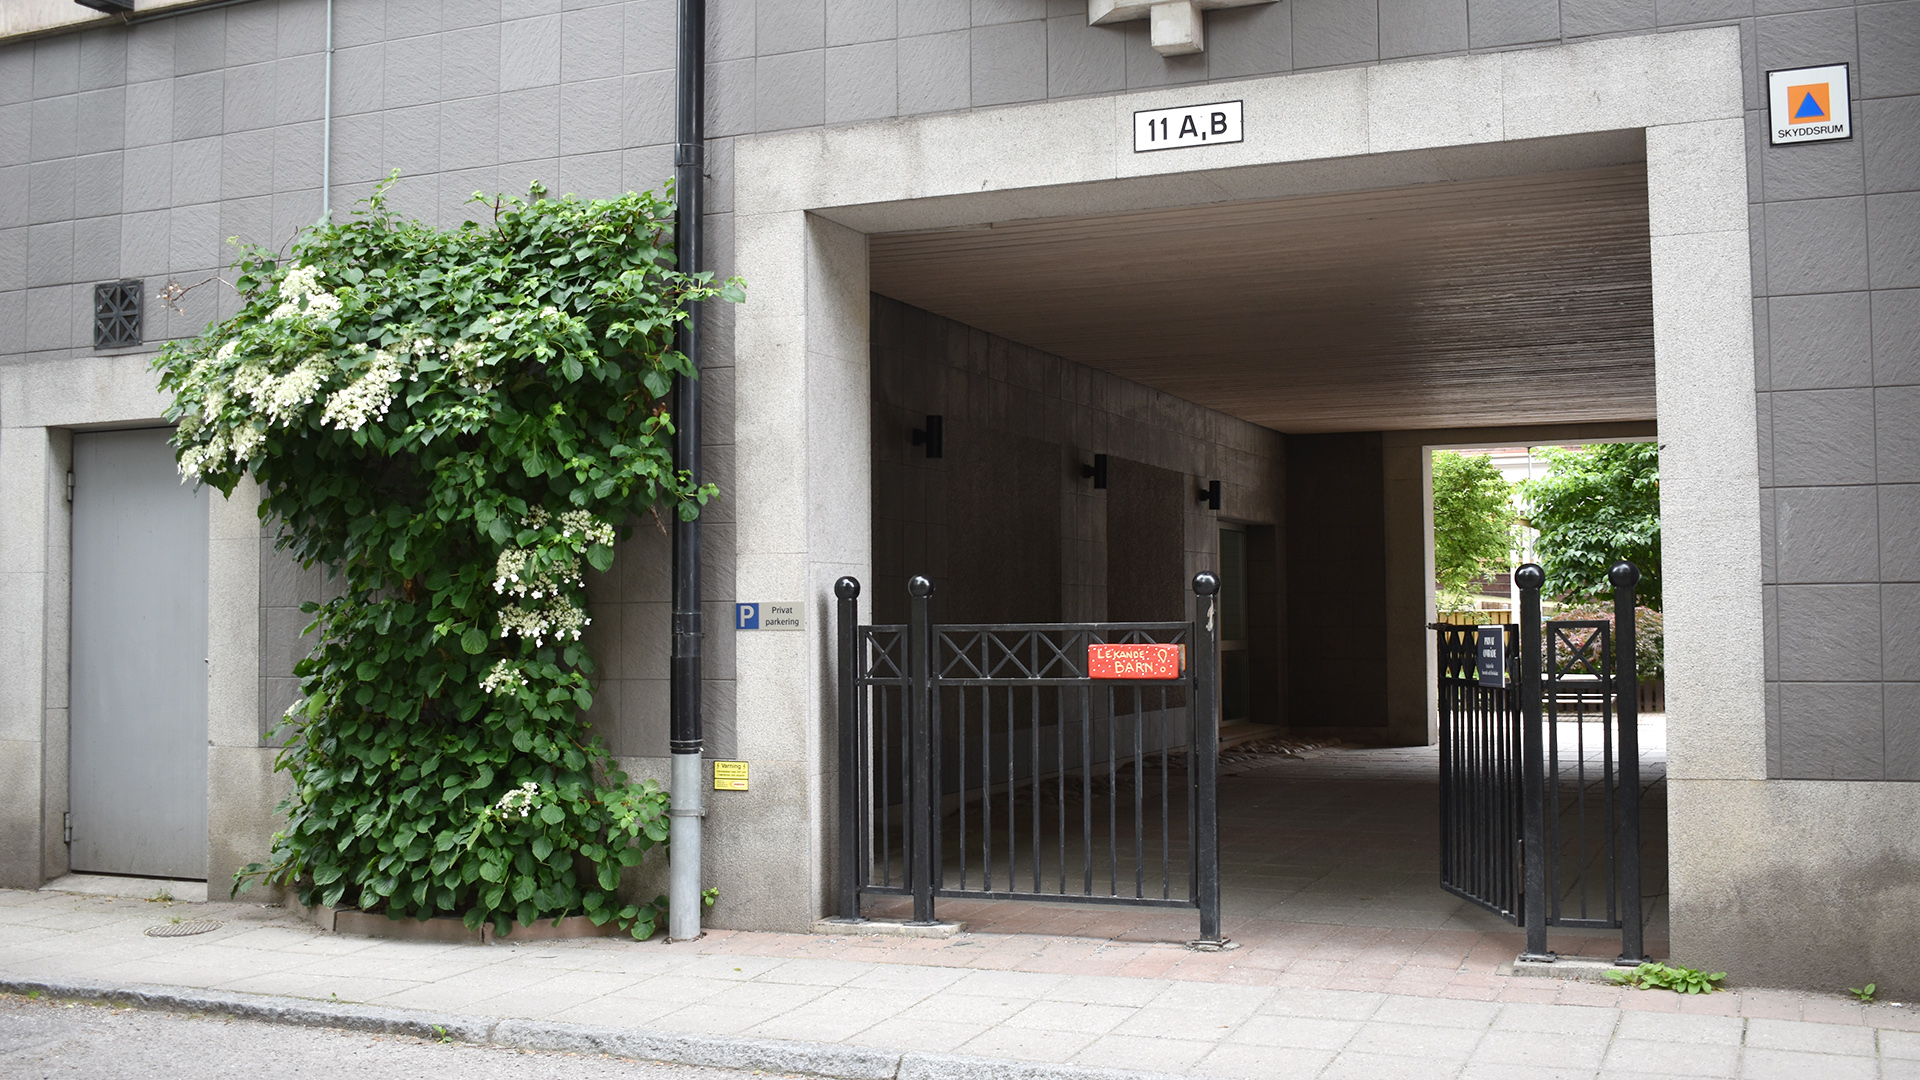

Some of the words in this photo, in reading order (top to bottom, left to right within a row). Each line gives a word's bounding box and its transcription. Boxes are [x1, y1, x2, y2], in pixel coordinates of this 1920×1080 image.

[1148, 119, 1167, 141] 11
[1179, 112, 1227, 141] A,B
[1778, 124, 1844, 138] SKYDDSRUM
[740, 605, 755, 628] P
[771, 606, 793, 614] Privat
[765, 618, 800, 627] parkering
[1097, 648, 1145, 660] LEKANDE
